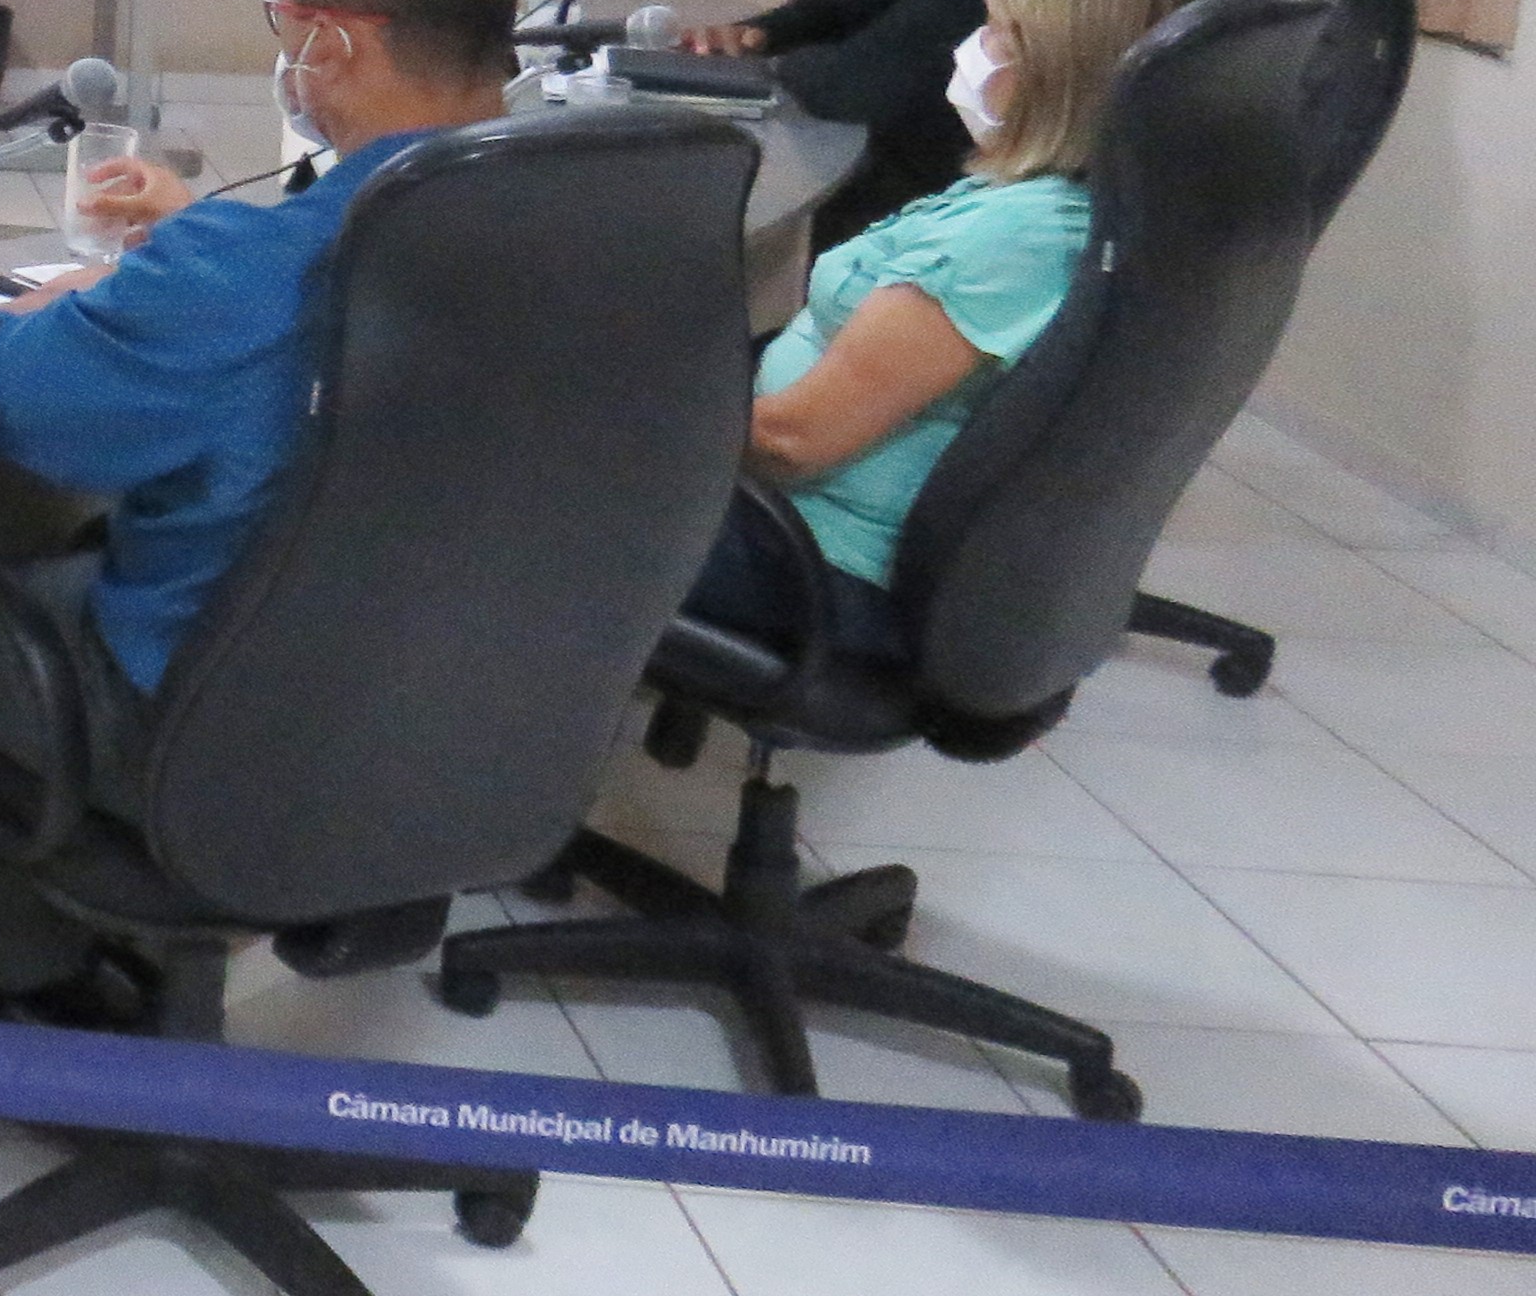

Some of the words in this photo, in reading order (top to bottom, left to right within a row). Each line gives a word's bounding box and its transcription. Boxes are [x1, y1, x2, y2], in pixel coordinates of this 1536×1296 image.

[328, 1091, 451, 1129] Câmara
[456, 1103, 613, 1145] Municipal
[619, 1119, 660, 1146] de
[666, 1122, 873, 1166] Manhumirim
